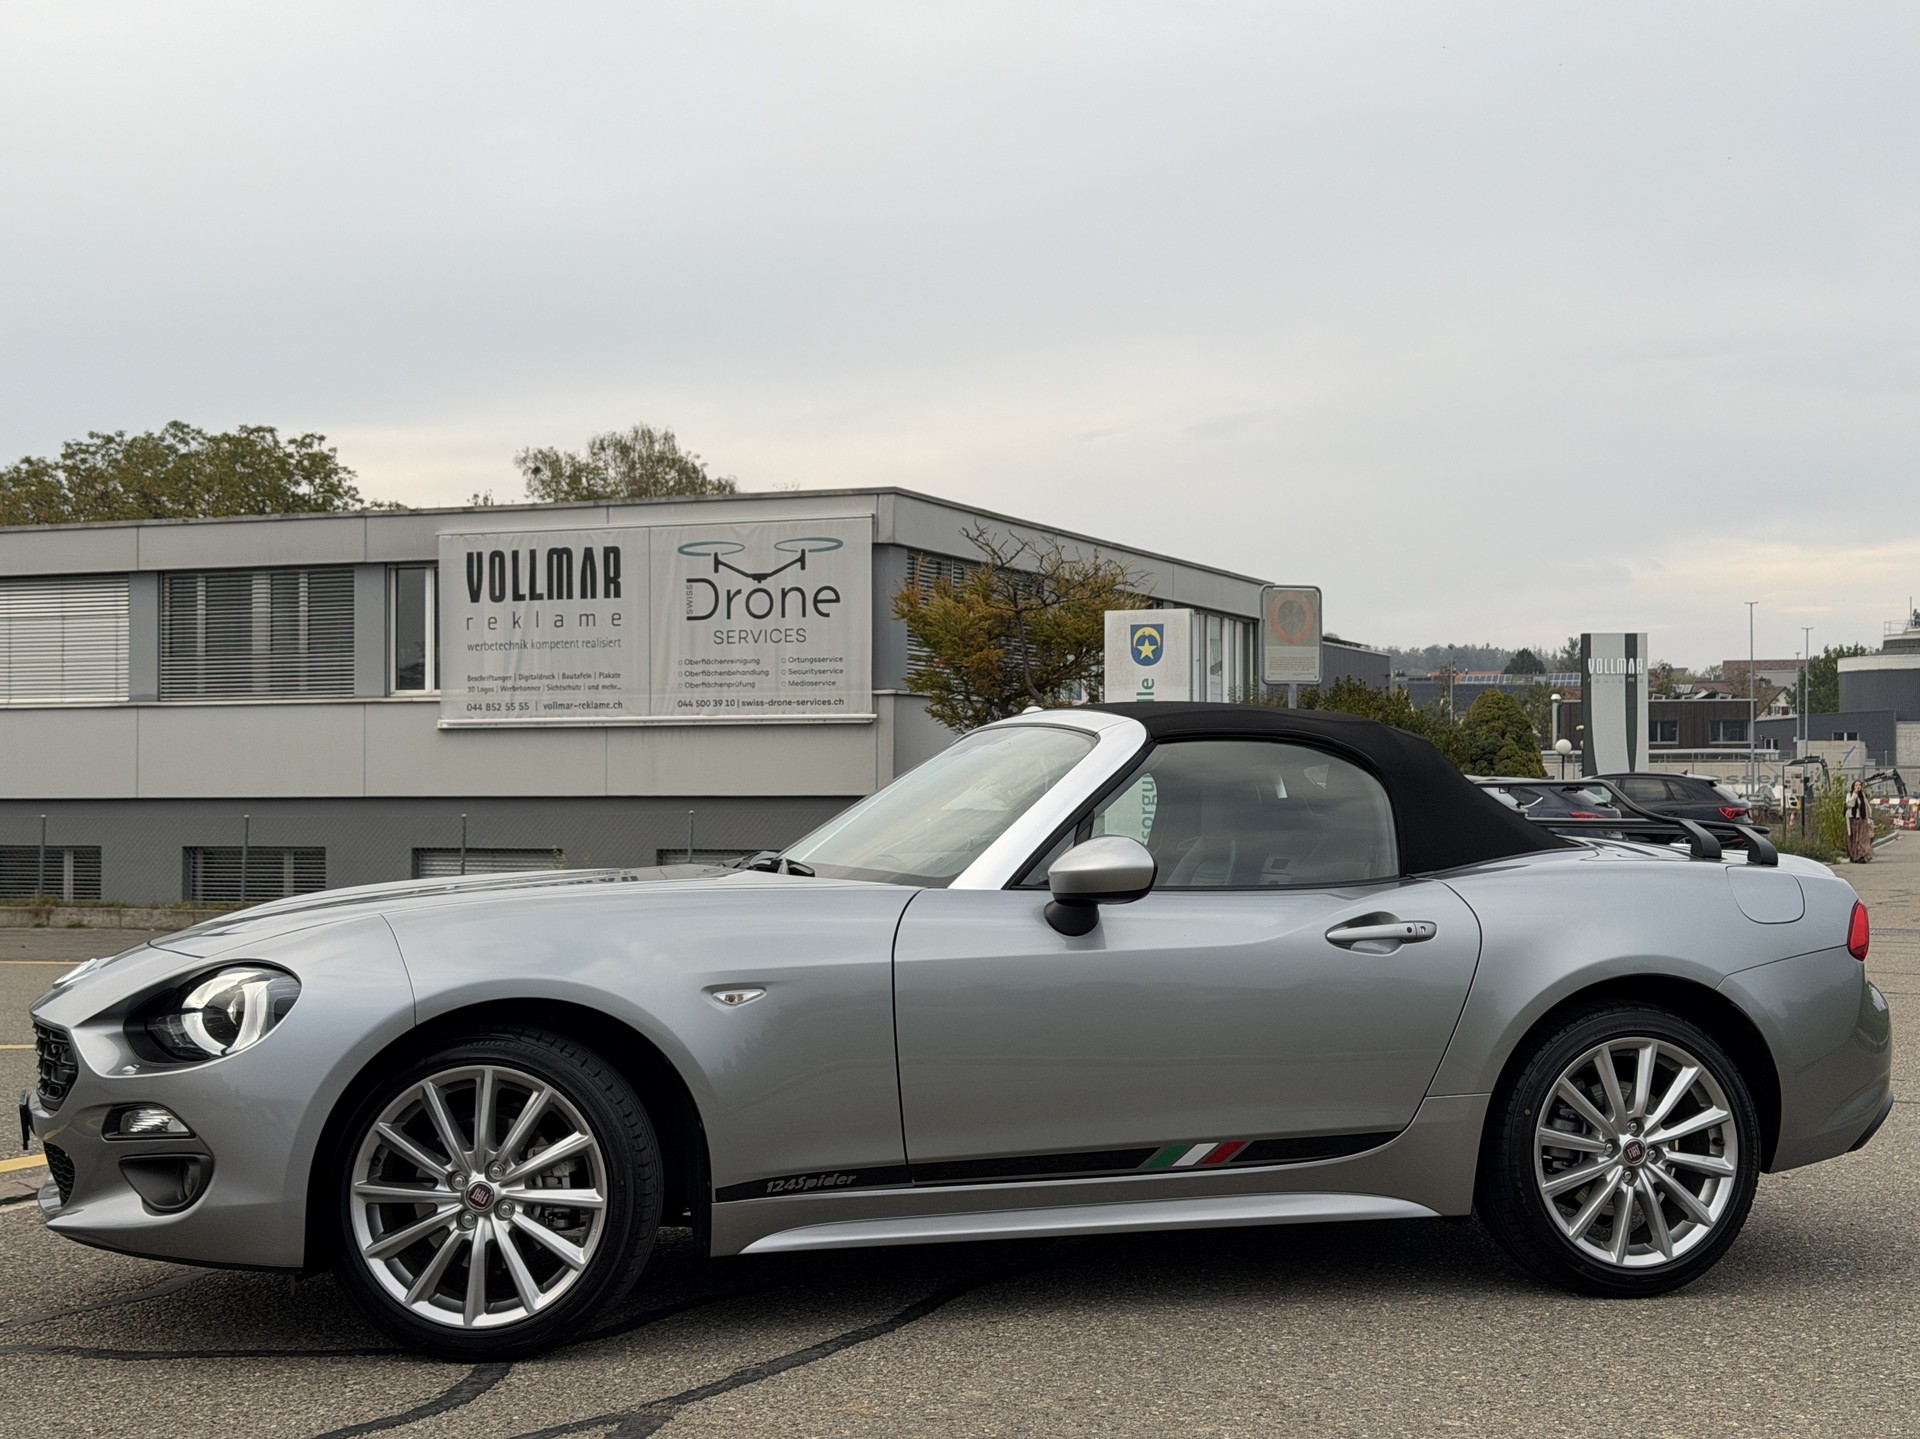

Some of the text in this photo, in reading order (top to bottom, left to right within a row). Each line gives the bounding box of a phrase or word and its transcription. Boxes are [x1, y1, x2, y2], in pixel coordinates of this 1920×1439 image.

[466, 546, 622, 603] VOLLMAR
[685, 583, 694, 615] SWISS
[686, 578, 841, 621] Drone
[466, 610, 622, 631] reklame
[713, 627, 807, 645] SERVICES
[467, 637, 622, 652] werbetechnik kompetent realisiert
[684, 657, 761, 666] Oberflächenreinigung
[788, 656, 844, 665] Ortungsservice
[1587, 657, 1643, 674] VOLLMAR
[467, 674, 513, 683] Beschriftungen
[518, 673, 556, 683] Digitaldruck
[561, 672, 592, 680] Bautafeln
[684, 669, 770, 678] Oberflächenbehandlung
[788, 667, 844, 677] Securityservice
[684, 680, 756, 689] Oberflächenprüfung
[788, 679, 837, 687] Mediaservice
[477, 686, 495, 695] Logos
[500, 685, 541, 693] Werbebanner
[466, 700, 624, 712] 044 852 55 55 vollmar-reklame.ch
[677, 697, 845, 708] 044 500 39 10 swiss-drone-services.ch
[1627, 1144, 1642, 1159] FIAT
[470, 1187, 490, 1204] FIAT
